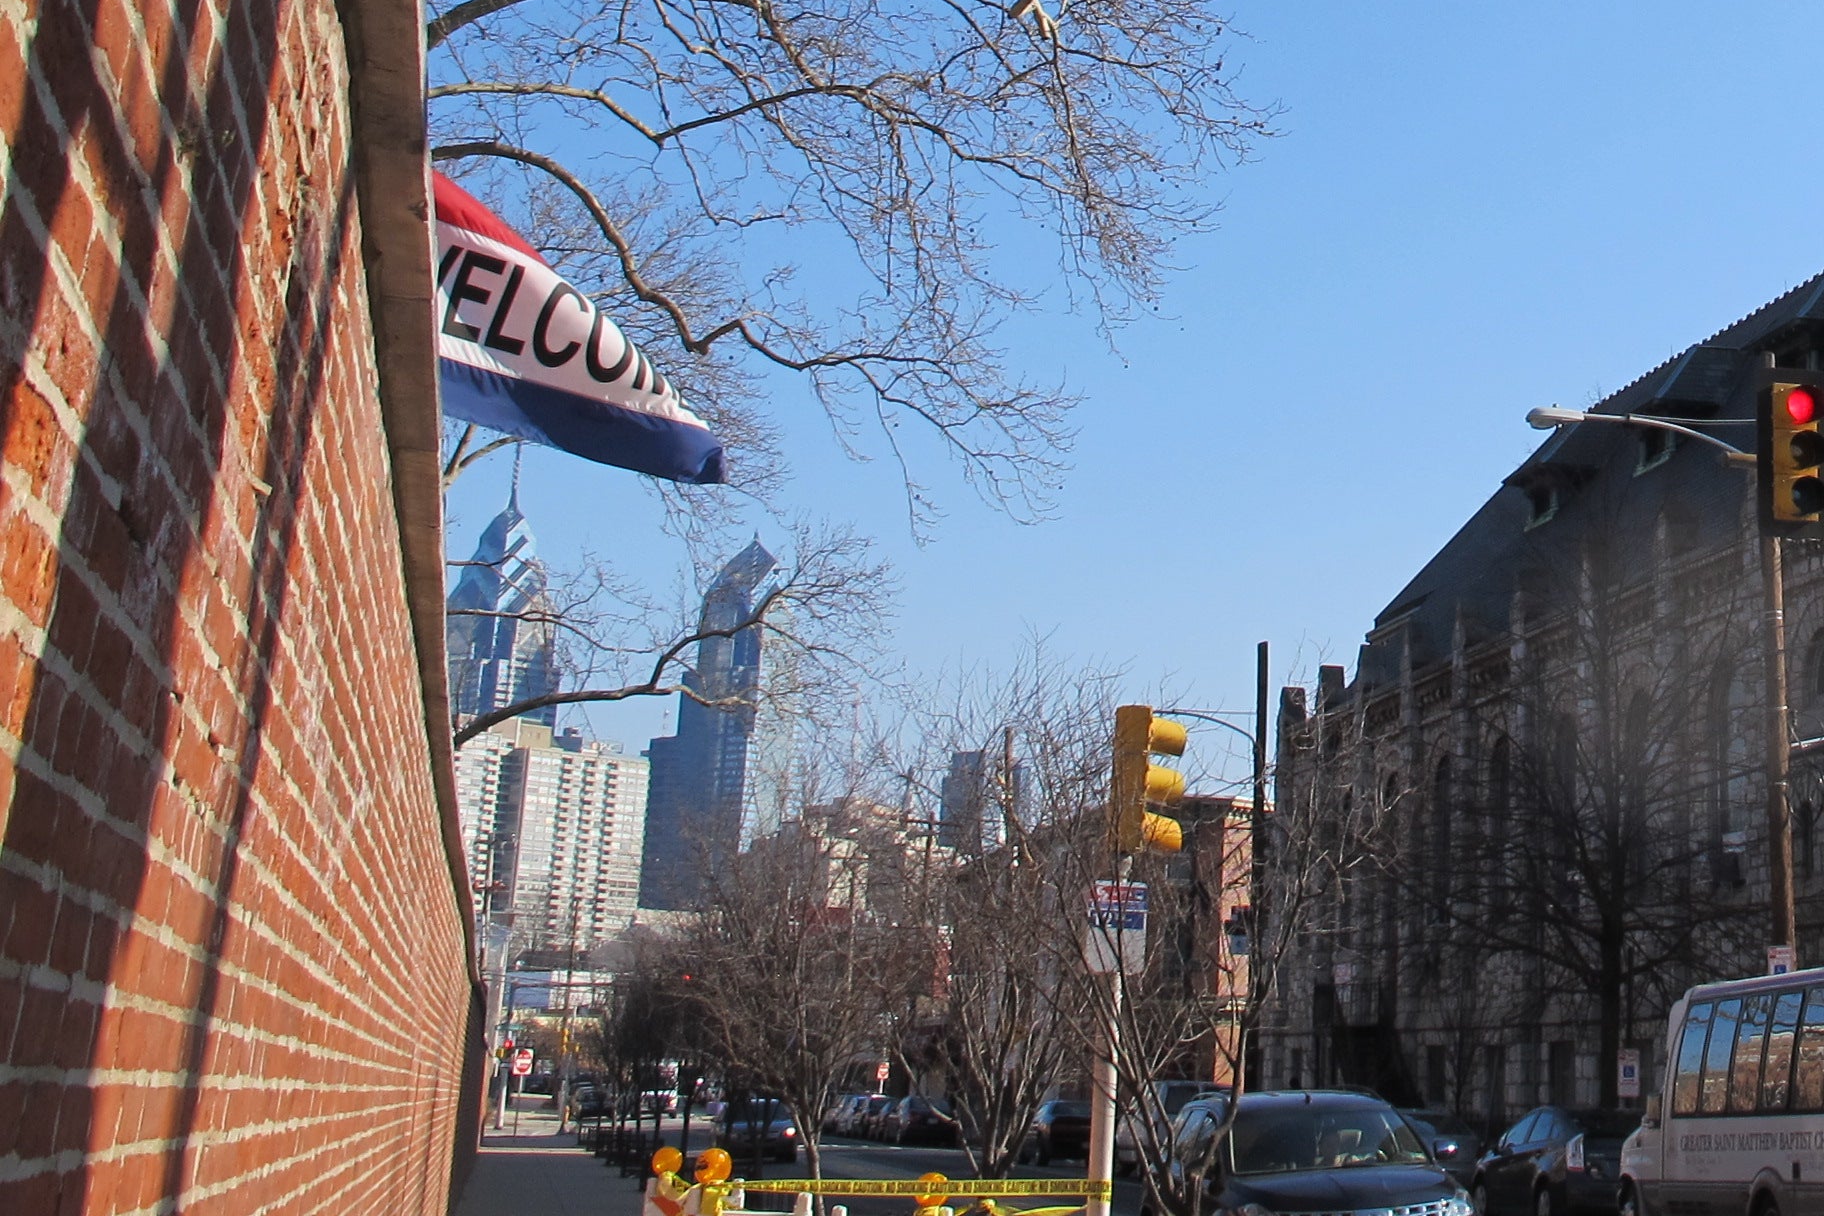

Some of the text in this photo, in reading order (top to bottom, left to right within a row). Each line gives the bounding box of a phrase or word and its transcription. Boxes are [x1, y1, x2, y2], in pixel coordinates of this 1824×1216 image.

[1680, 1134, 1713, 1151] GREATER
[1714, 1133, 1736, 1151] SAINT
[1737, 1132, 1777, 1151] MATTHEW
[1779, 1132, 1812, 1150] BAPTIST
